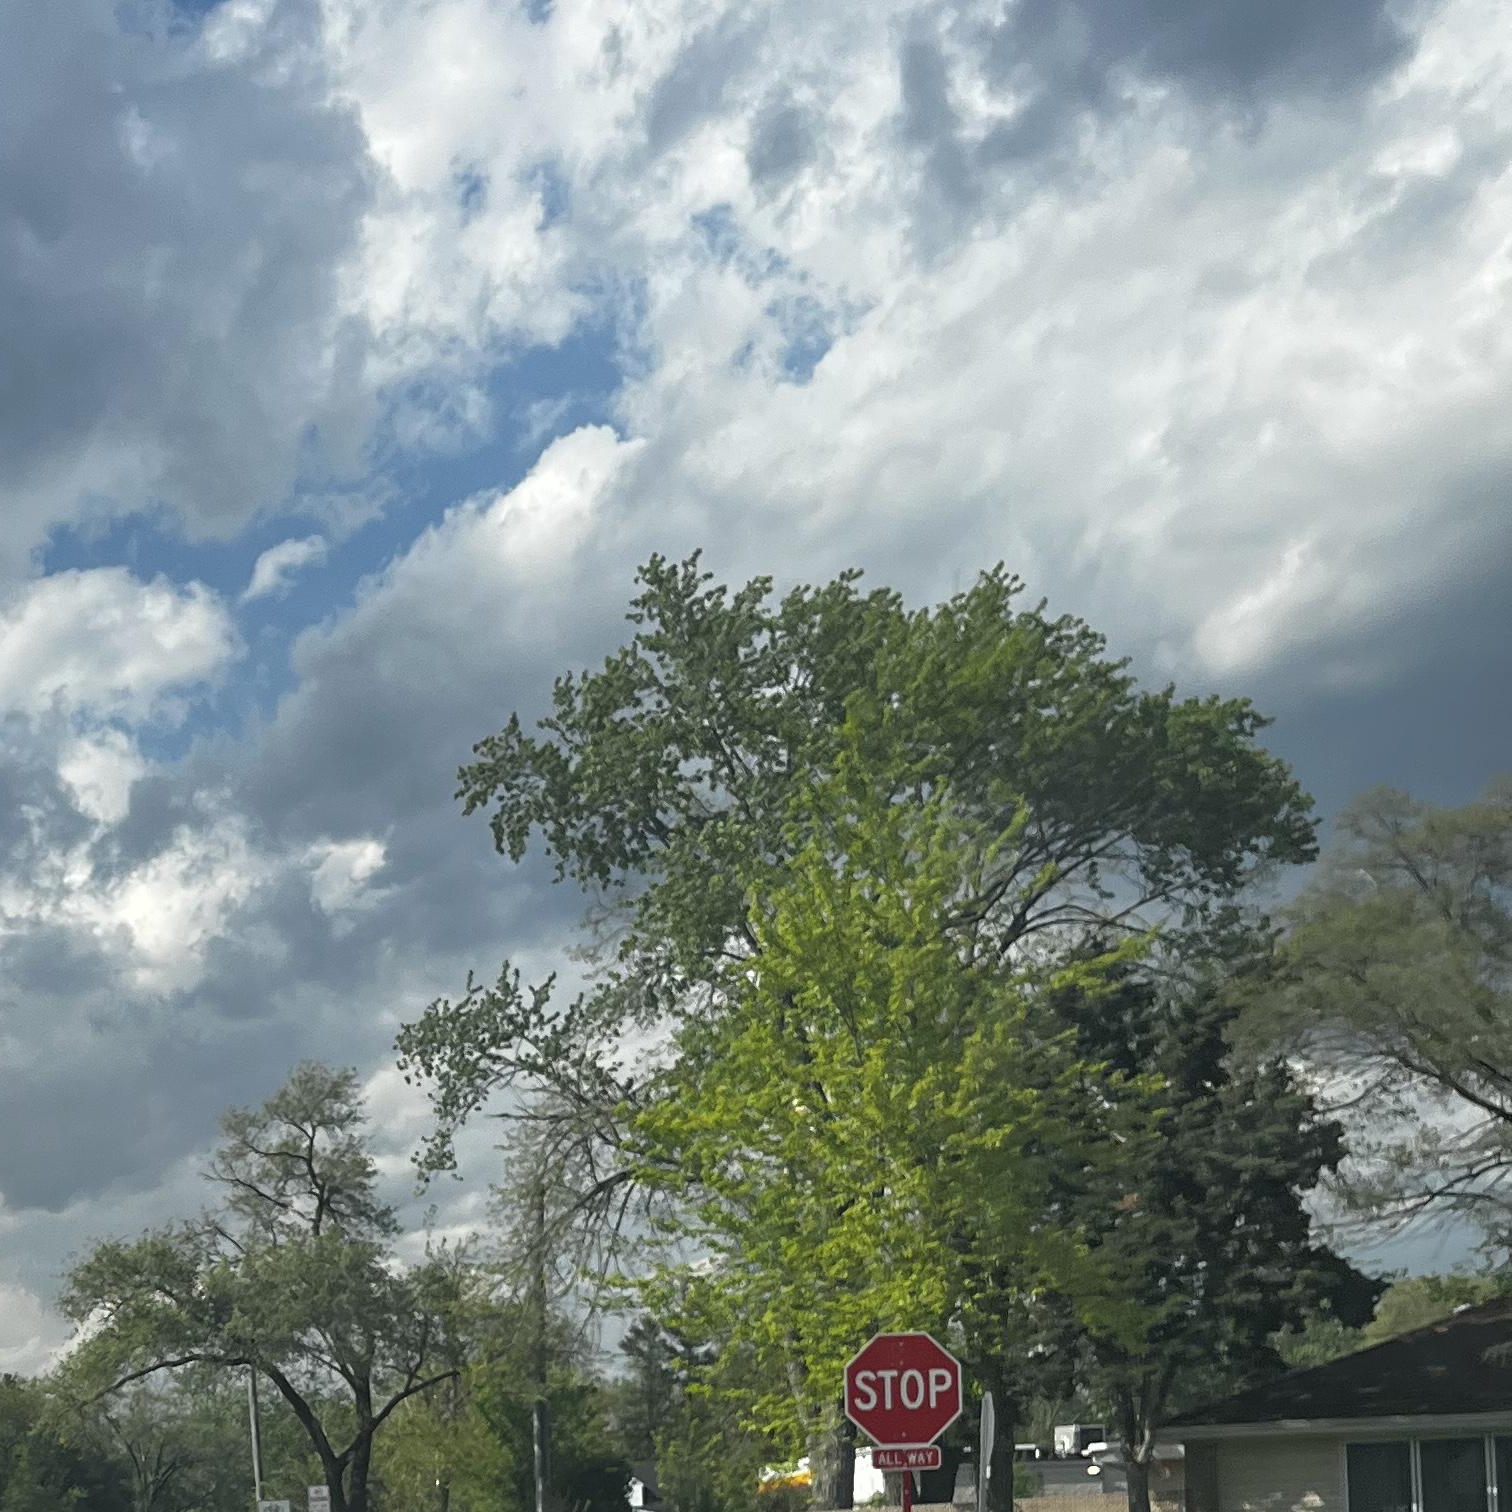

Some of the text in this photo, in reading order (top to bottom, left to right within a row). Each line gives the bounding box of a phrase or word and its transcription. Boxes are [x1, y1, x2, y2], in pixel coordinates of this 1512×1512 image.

[854, 1368, 952, 1411] STOP
[878, 1450, 933, 1465] ALL WAY
